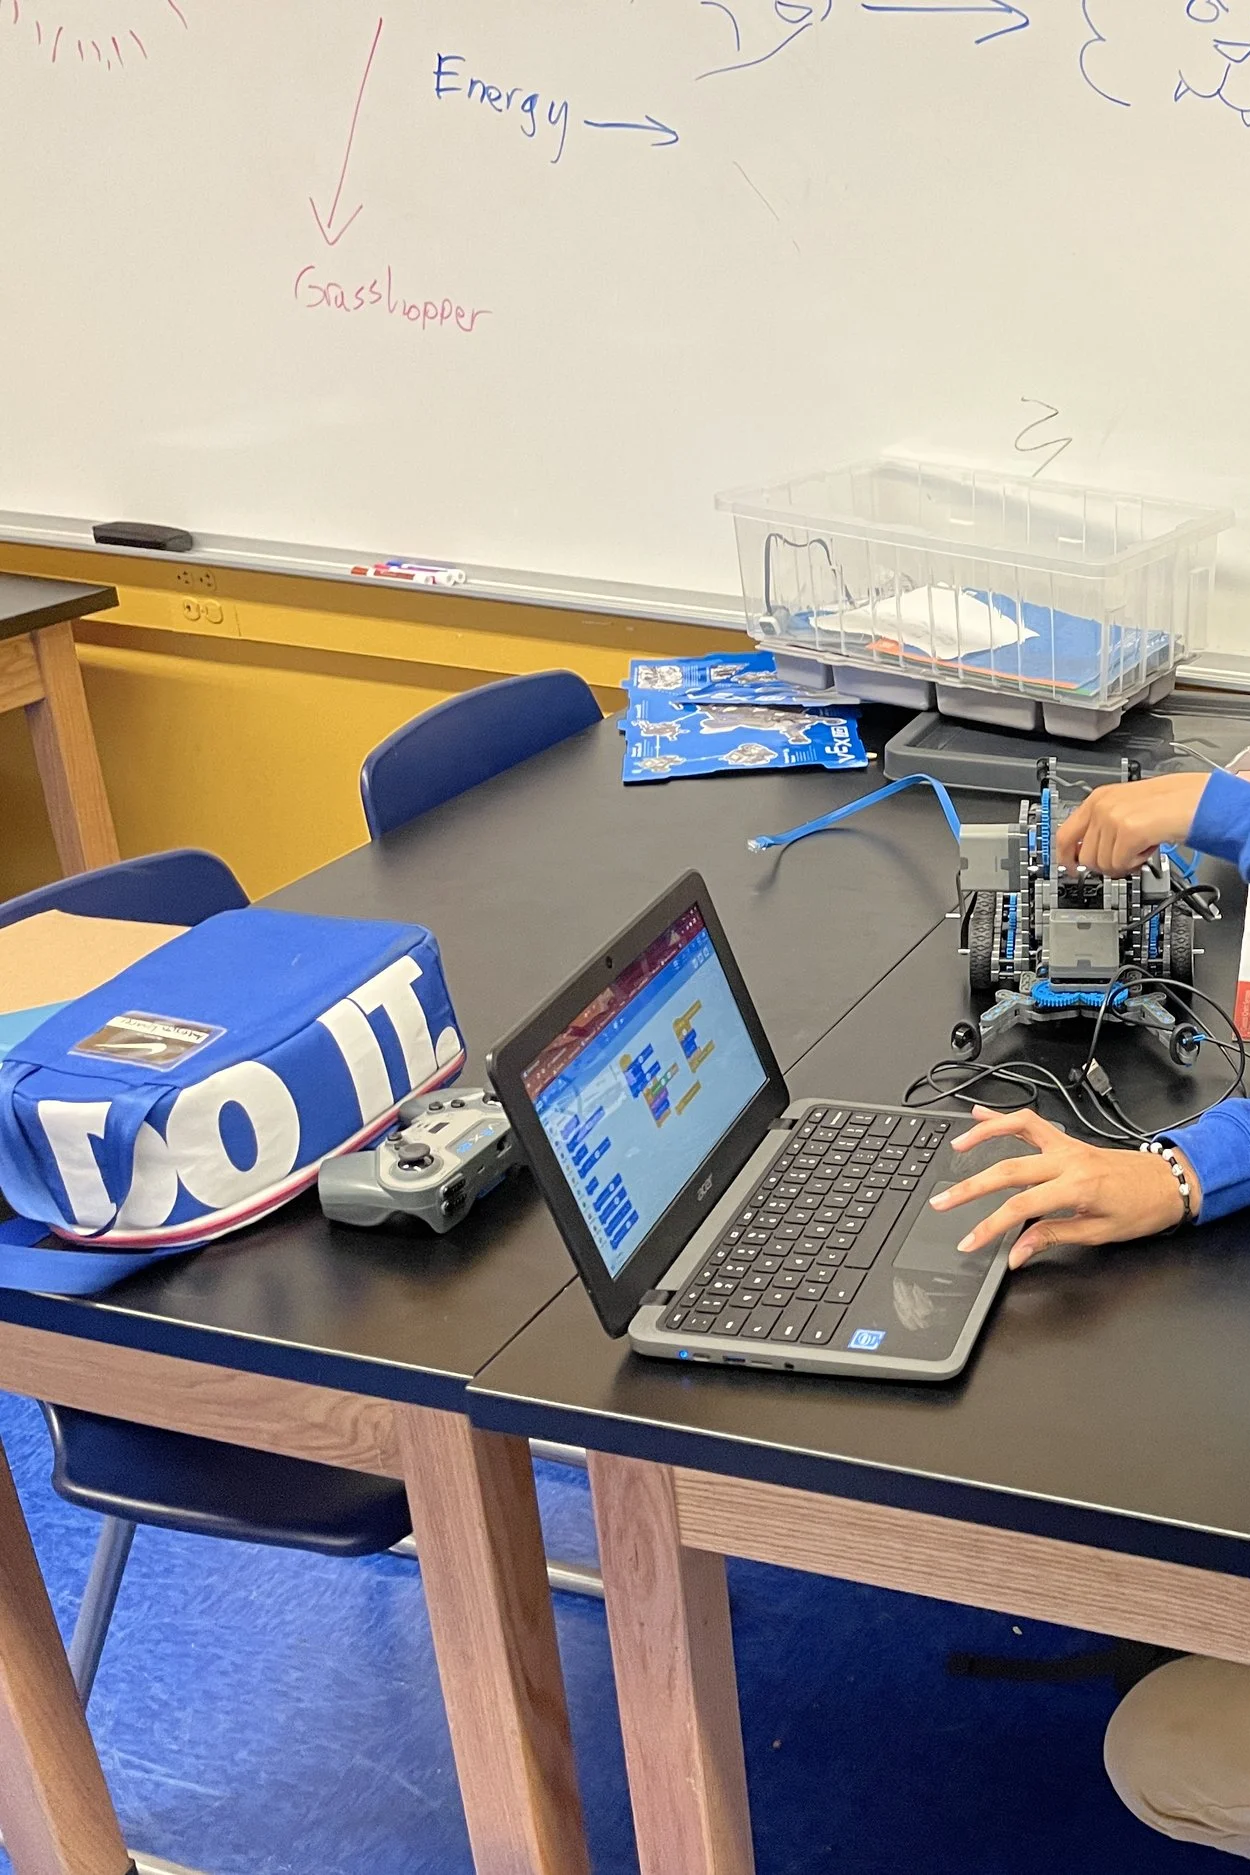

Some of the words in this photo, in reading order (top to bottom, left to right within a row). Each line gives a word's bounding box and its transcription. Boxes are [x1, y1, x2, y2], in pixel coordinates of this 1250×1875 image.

[433, 52, 569, 164] Energy
[294, 264, 493, 332] Grasshopper
[696, 1172, 713, 1202] acer
